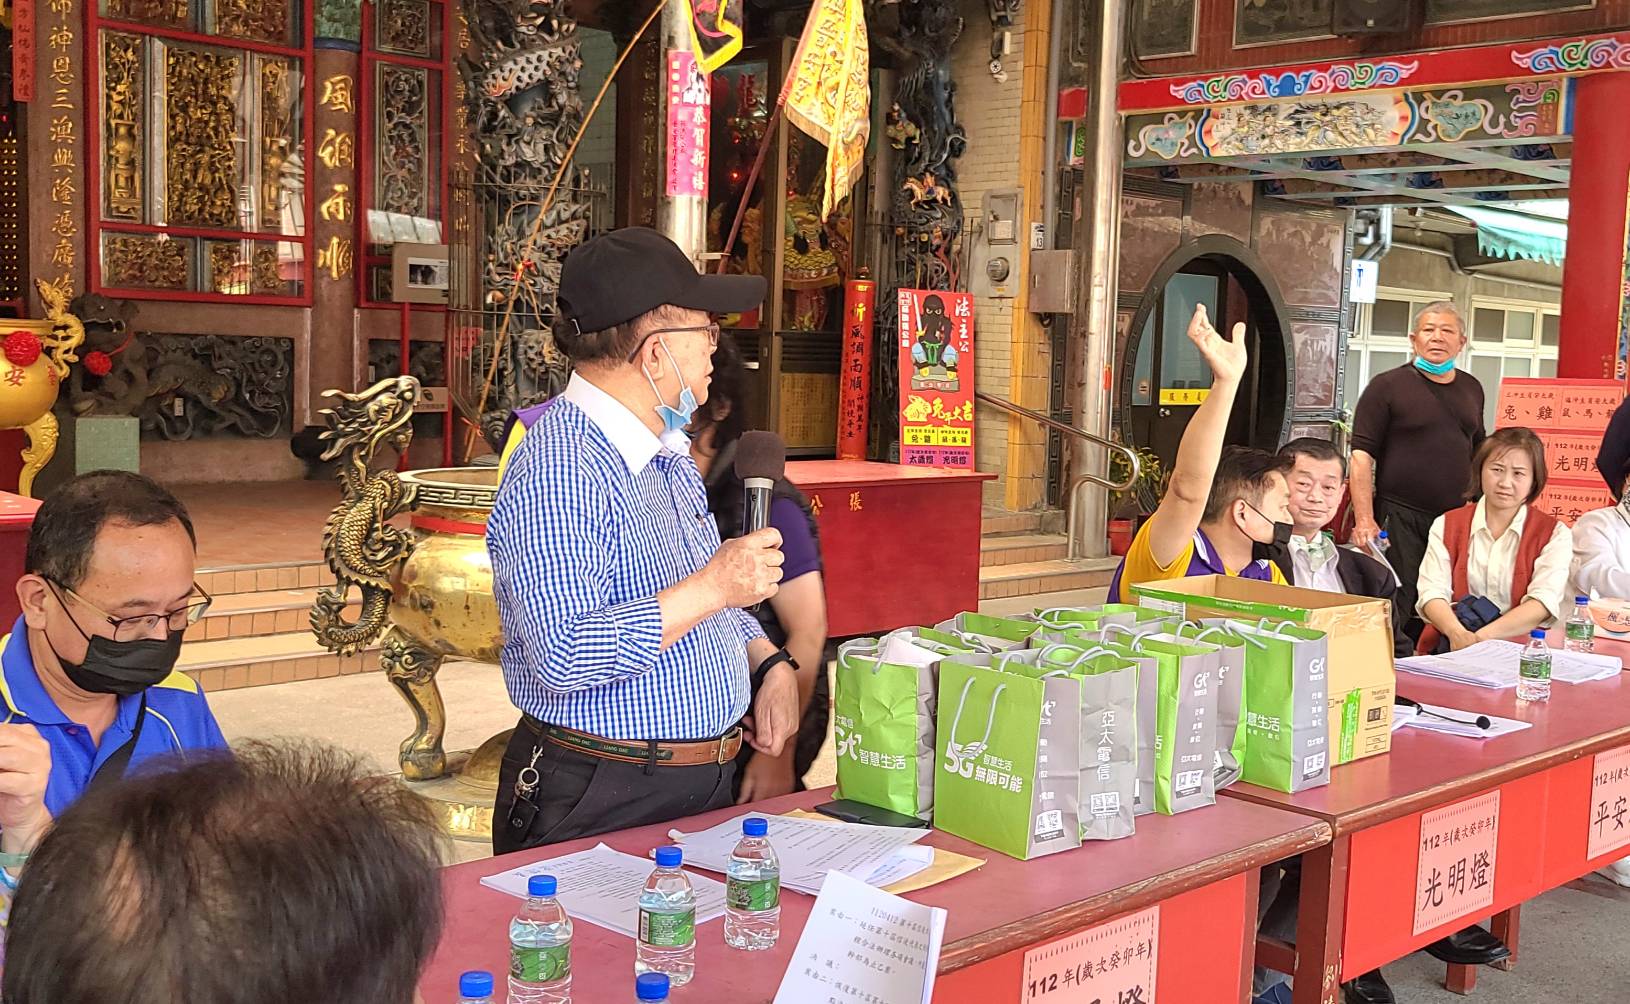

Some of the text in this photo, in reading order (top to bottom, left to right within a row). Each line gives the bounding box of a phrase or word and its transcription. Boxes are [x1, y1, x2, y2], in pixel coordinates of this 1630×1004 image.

[955, 296, 970, 353] 法主公
[4, 366, 26, 387] 安
[849, 491, 863, 512] 張
[858, 748, 906, 770] 智慧生活
[1096, 710, 1117, 783] 亞太電信
[982, 753, 1014, 772] 智慧生活
[974, 765, 1024, 793] 無限可能
[1594, 795, 1628, 838] 平安
[1421, 849, 1491, 912] 光明燈
